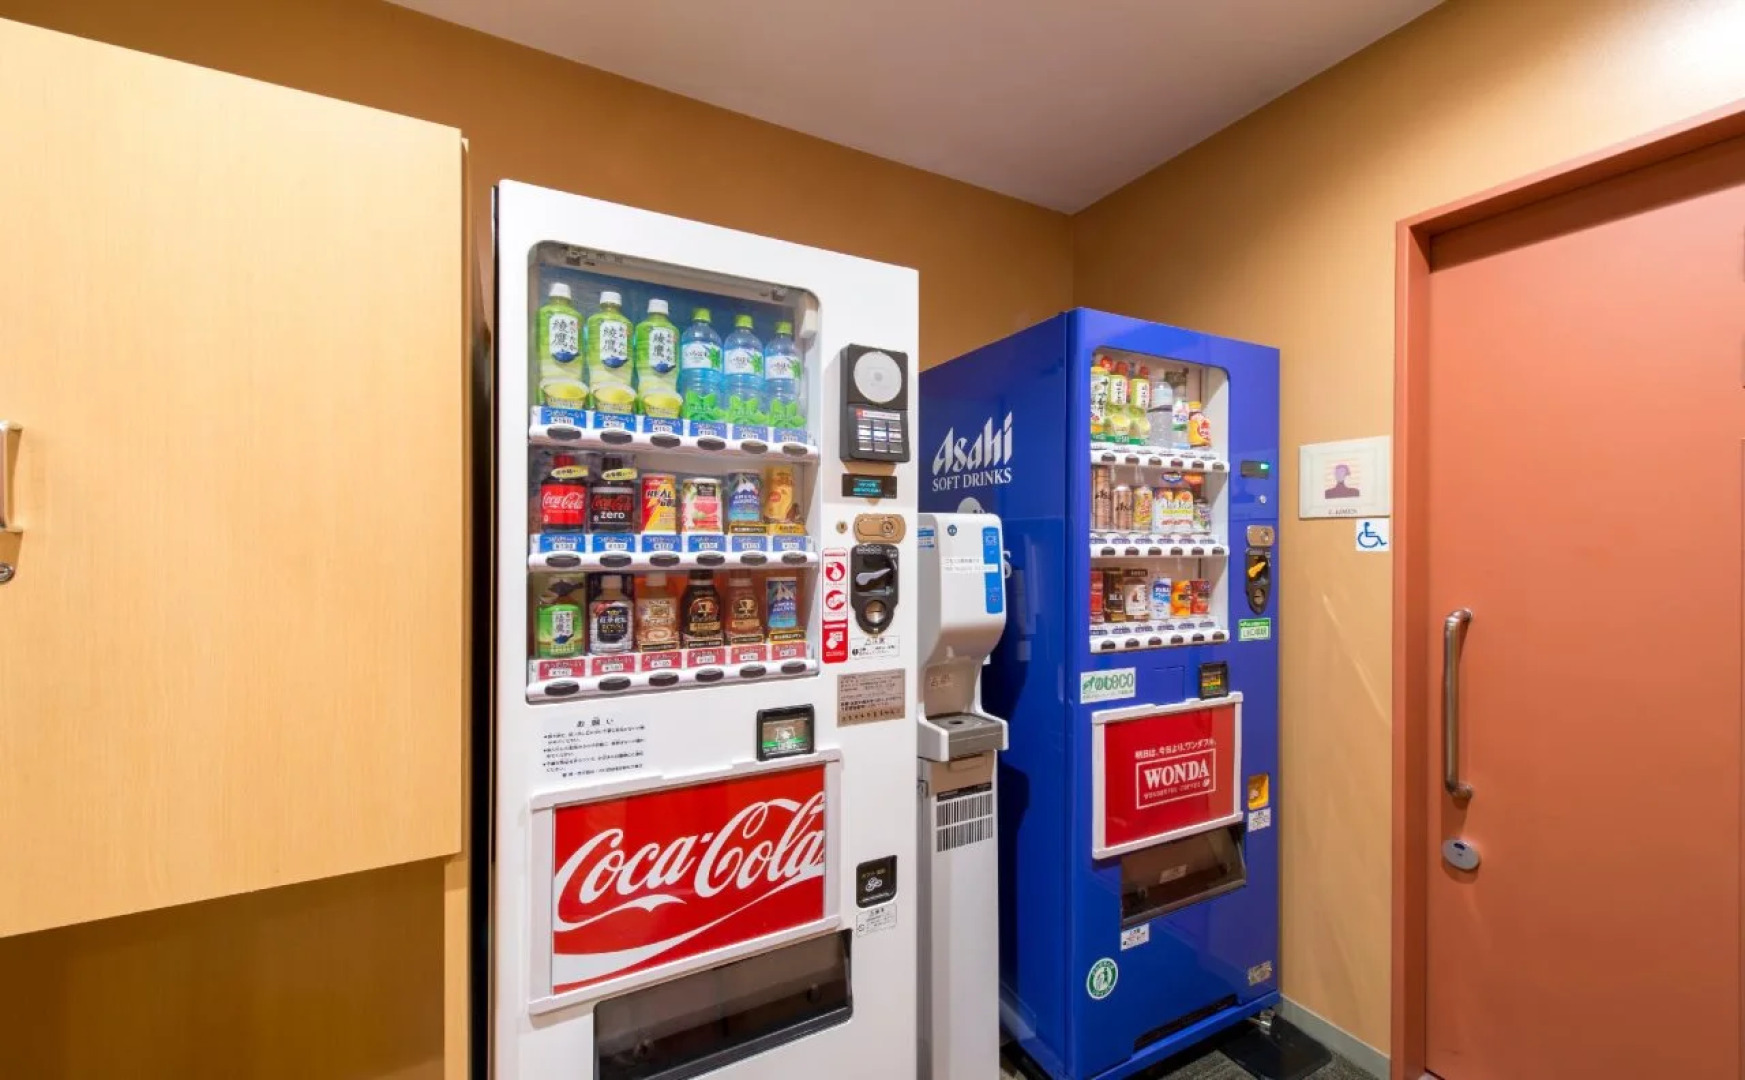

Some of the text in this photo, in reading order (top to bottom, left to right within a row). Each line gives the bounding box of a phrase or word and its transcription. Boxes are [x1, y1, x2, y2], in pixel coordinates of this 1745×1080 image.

[932, 410, 1013, 476] Asahi
[932, 467, 1012, 492] SOFT DRINKS
[600, 511, 625, 519] zero
[1143, 758, 1211, 790] WONDA
[553, 790, 825, 932] Coca-Cola
